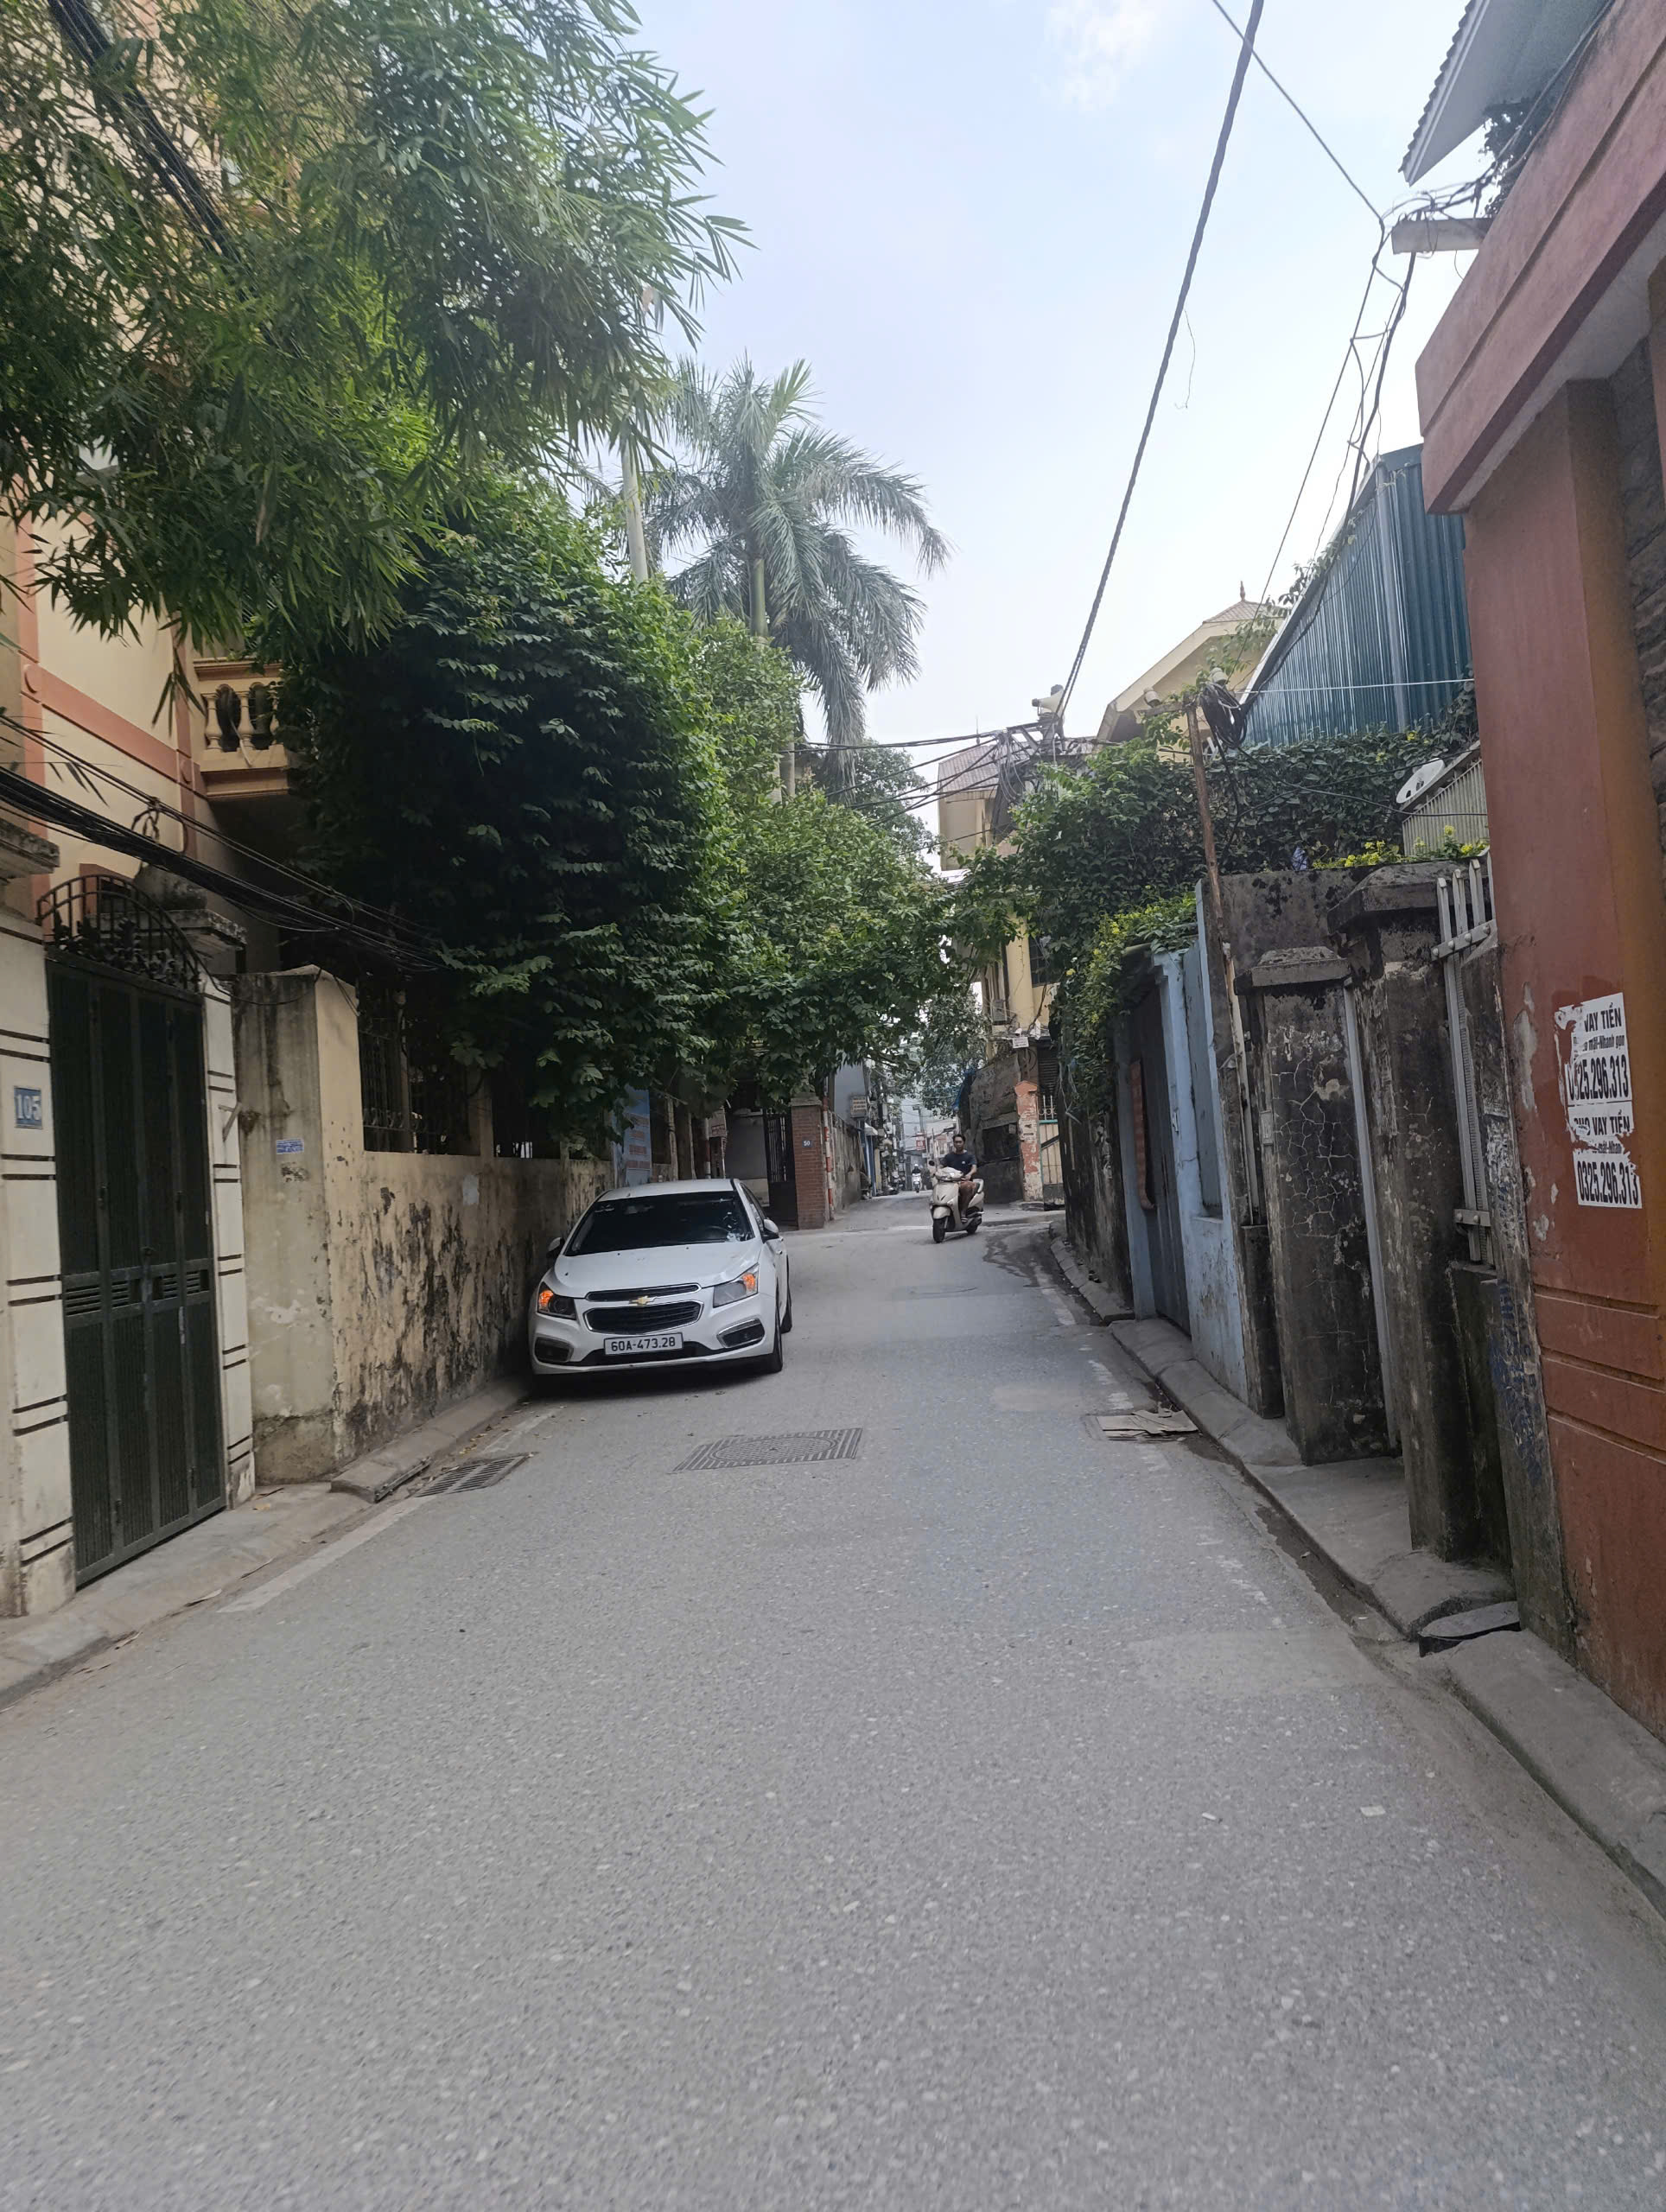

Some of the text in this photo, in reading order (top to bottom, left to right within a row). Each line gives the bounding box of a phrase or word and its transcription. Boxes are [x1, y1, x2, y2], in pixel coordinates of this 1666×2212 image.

[1584, 1011, 1598, 1032] VAY
[14, 1093, 41, 1121] 105
[1592, 1116, 1607, 1135] VAY
[1577, 1160, 1639, 1205] 0325.296.313
[611, 1336, 676, 1351] 60A-473.28
